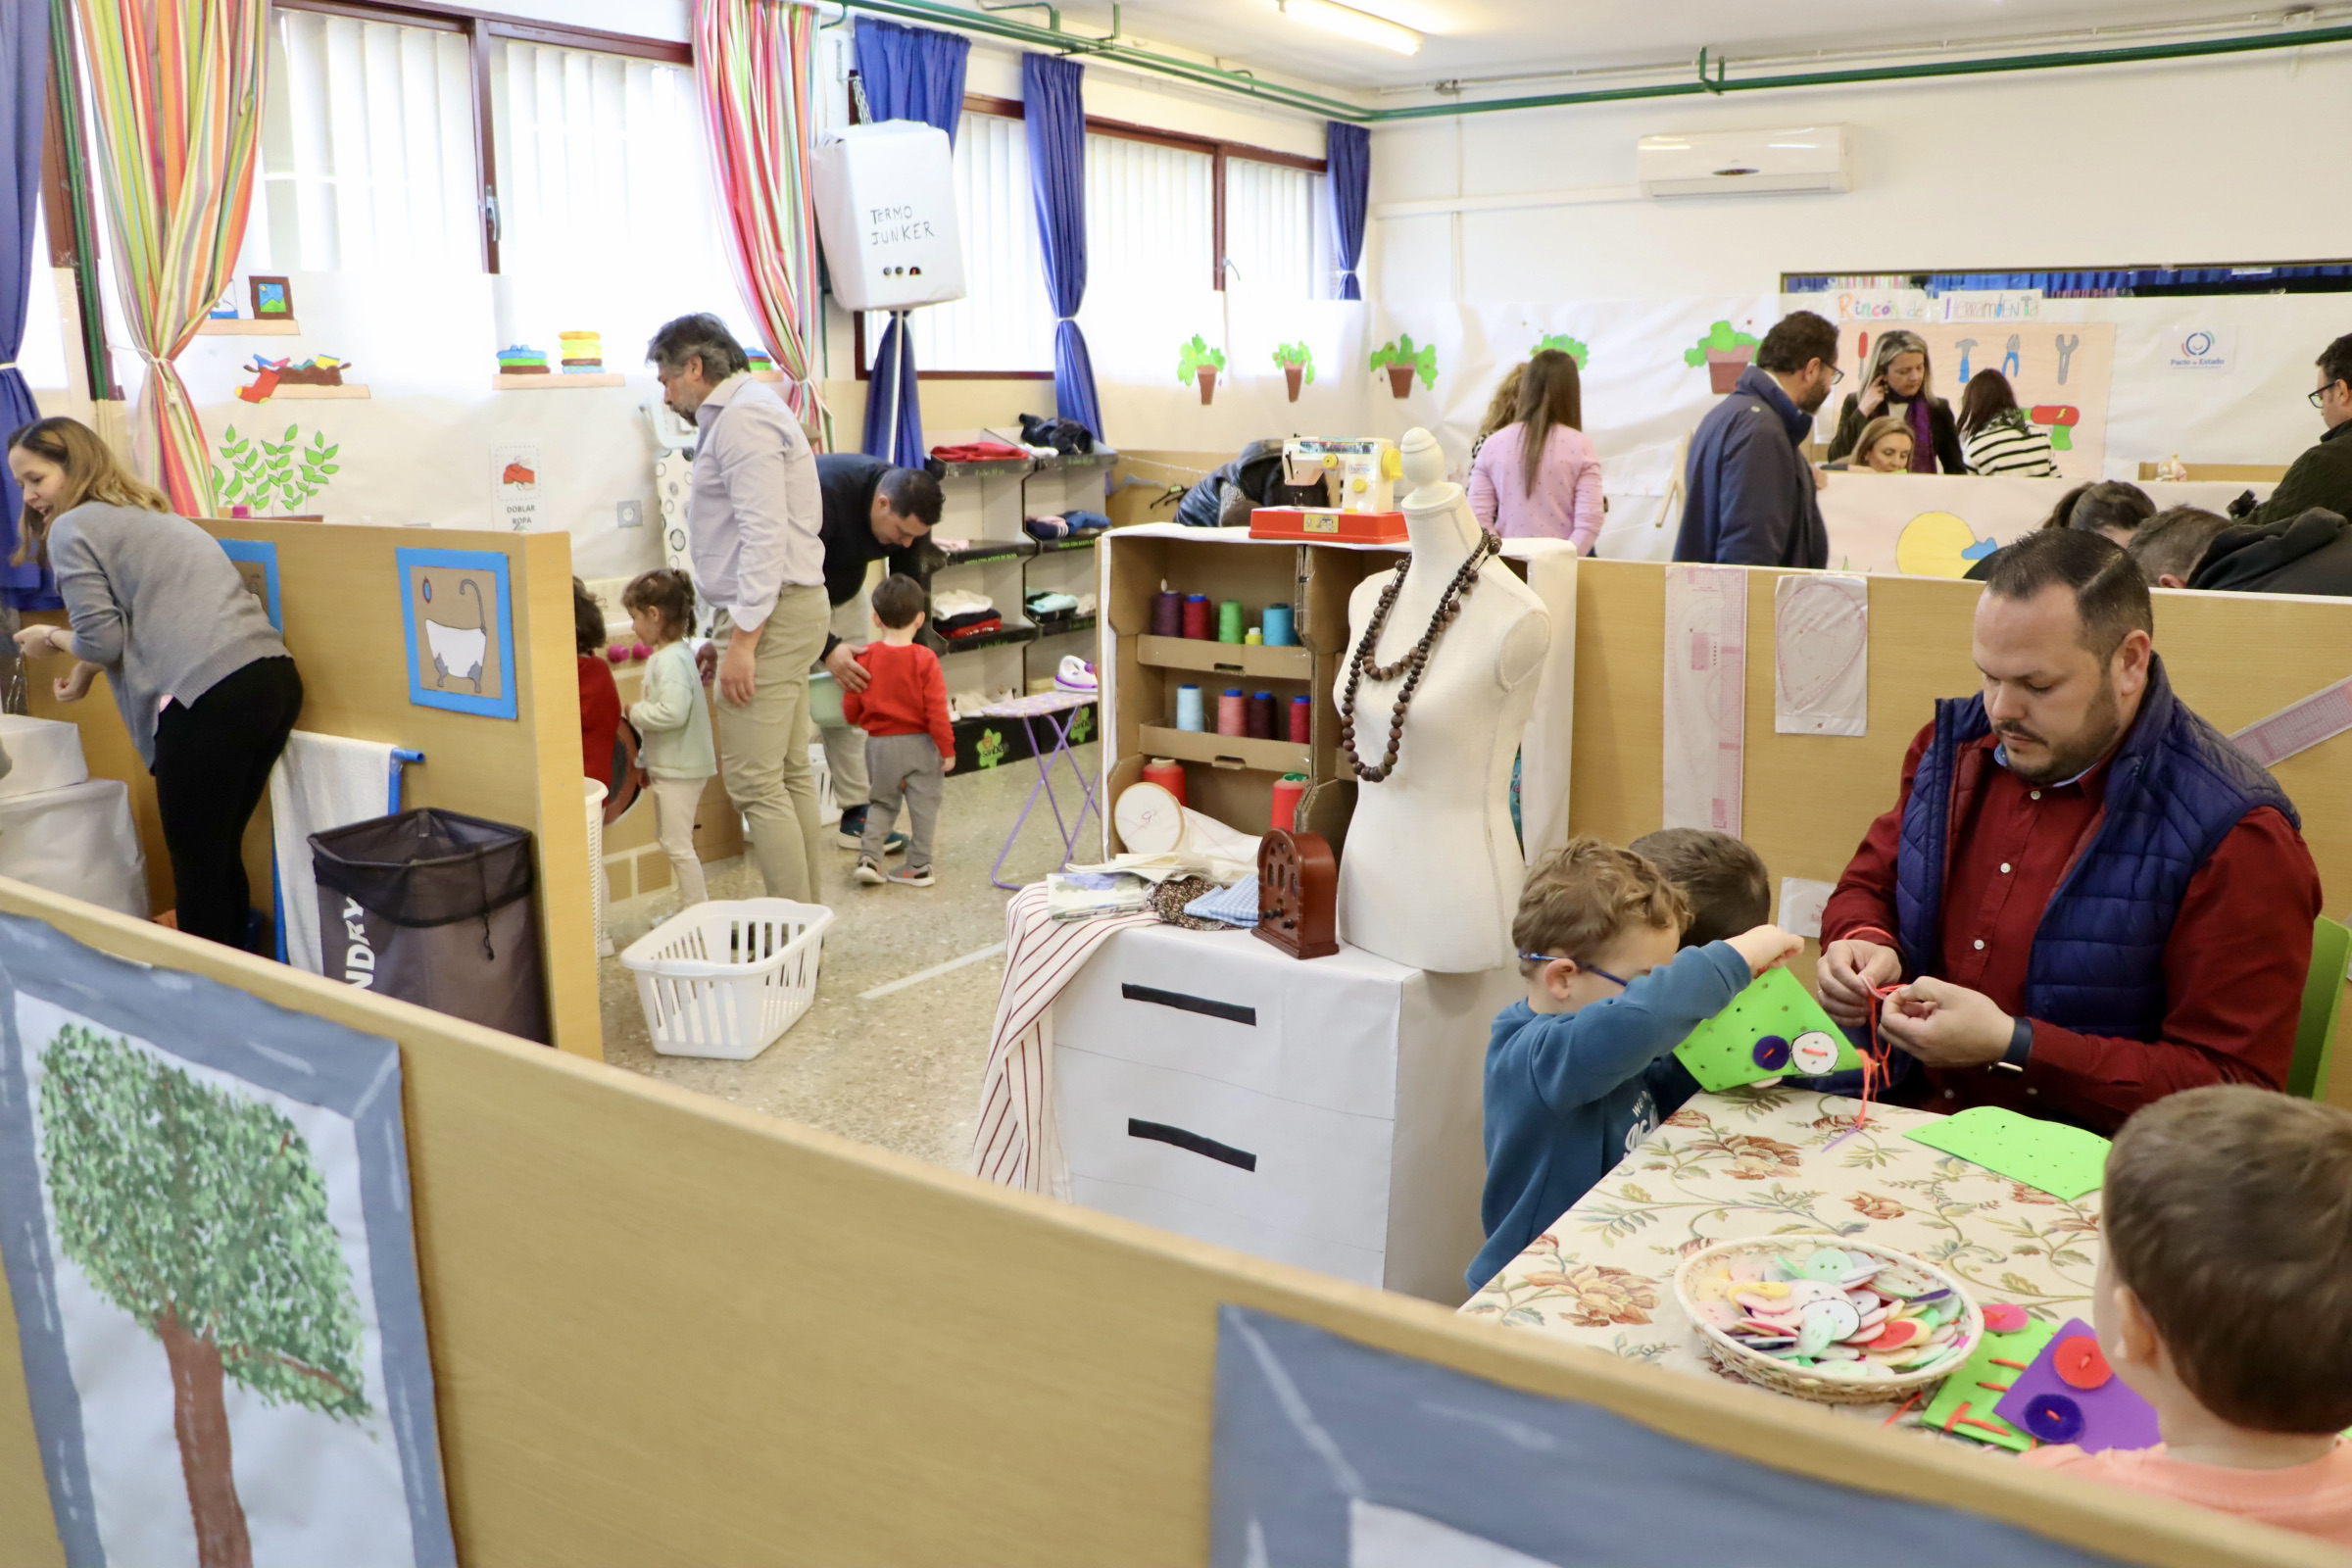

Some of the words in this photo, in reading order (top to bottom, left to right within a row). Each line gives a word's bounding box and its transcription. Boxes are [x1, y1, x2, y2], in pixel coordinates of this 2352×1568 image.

[869, 205, 913, 224] TERMO
[870, 220, 935, 246] JUNKER
[1838, 293, 1899, 320] Rincón
[1906, 300, 1924, 318] de
[506, 505, 536, 514] DOBLAR
